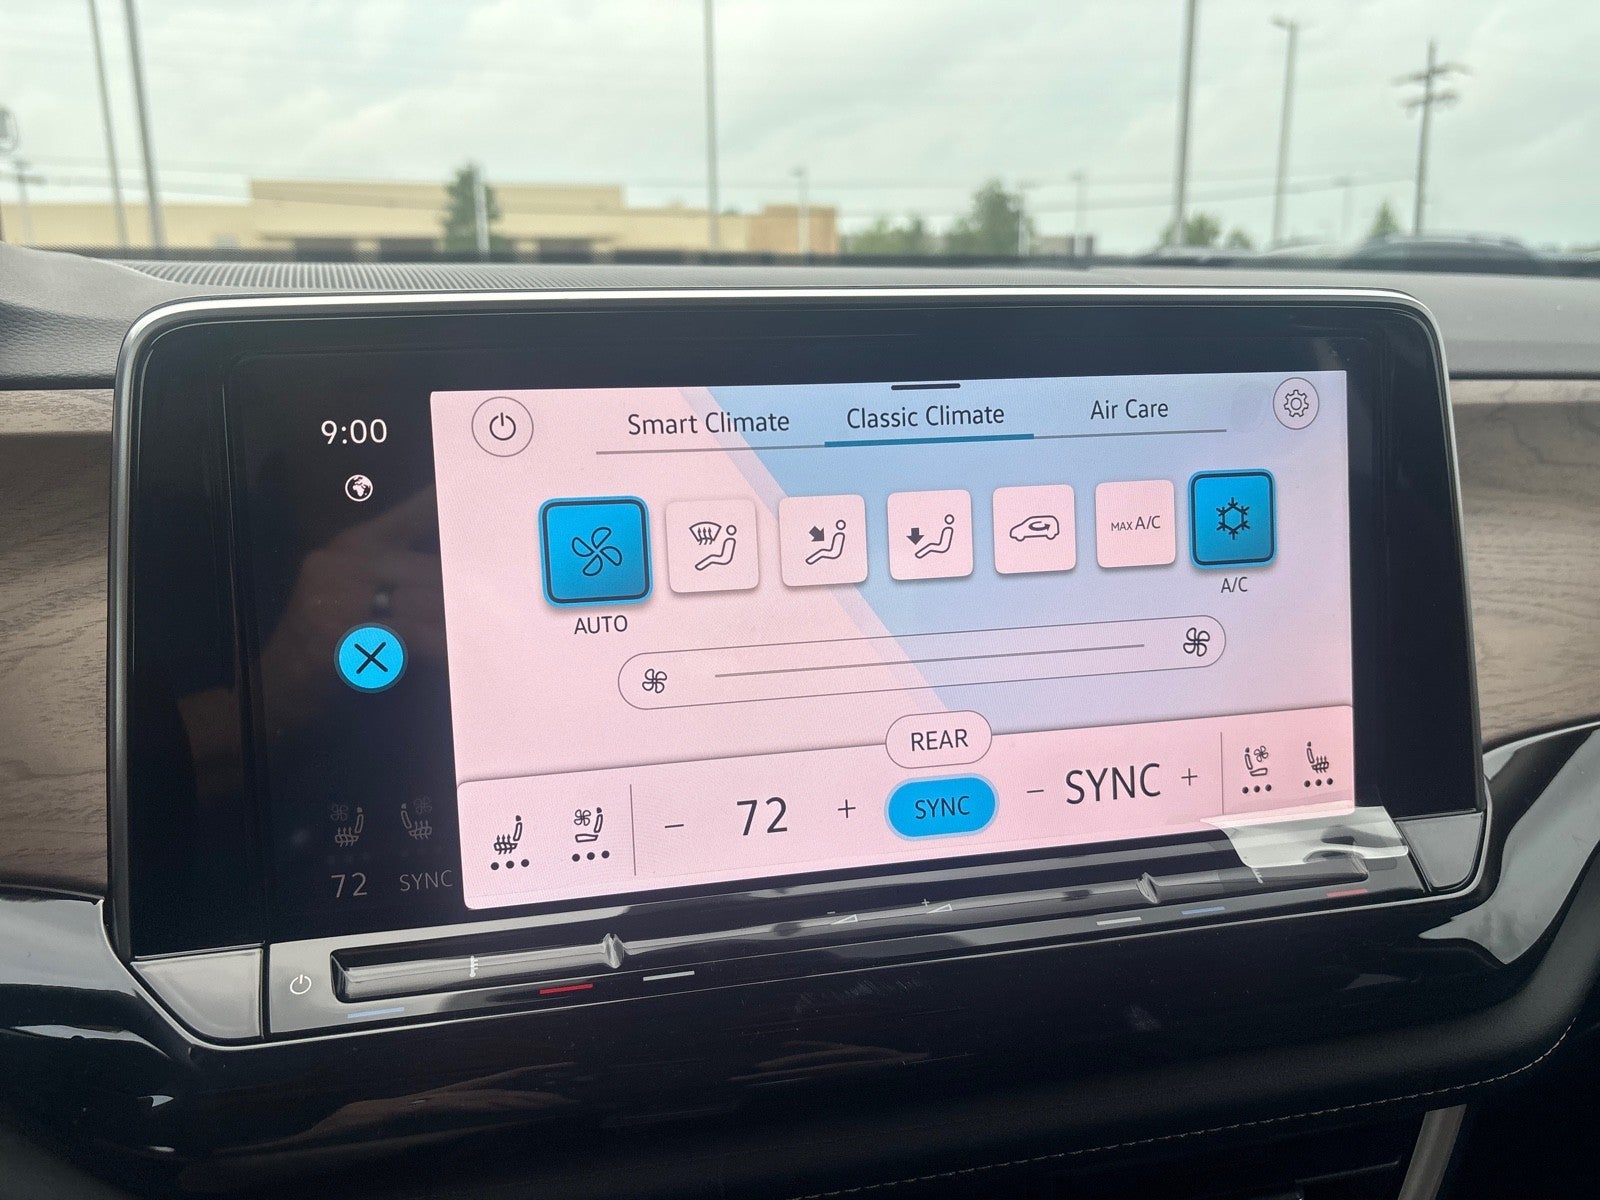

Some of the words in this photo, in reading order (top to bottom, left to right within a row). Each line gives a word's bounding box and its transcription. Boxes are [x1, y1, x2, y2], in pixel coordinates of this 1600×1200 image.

[846, 407, 919, 429] Classic
[925, 404, 1005, 426] Climate
[1090, 400, 1119, 420] Air
[1126, 398, 1169, 419] Care
[320, 418, 388, 444] 9:00
[627, 413, 698, 436] Smart
[705, 410, 790, 433] Climate
[1110, 520, 1133, 532] MAX
[1134, 513, 1162, 532] A/C
[1220, 576, 1248, 593] A/C
[573, 614, 629, 635] AUTO
[910, 728, 969, 752] REAR
[1064, 762, 1162, 805] SYNC
[736, 796, 789, 836] 72
[914, 795, 970, 819] SYNC
[330, 871, 369, 898] 72
[399, 869, 453, 892] SYNC
